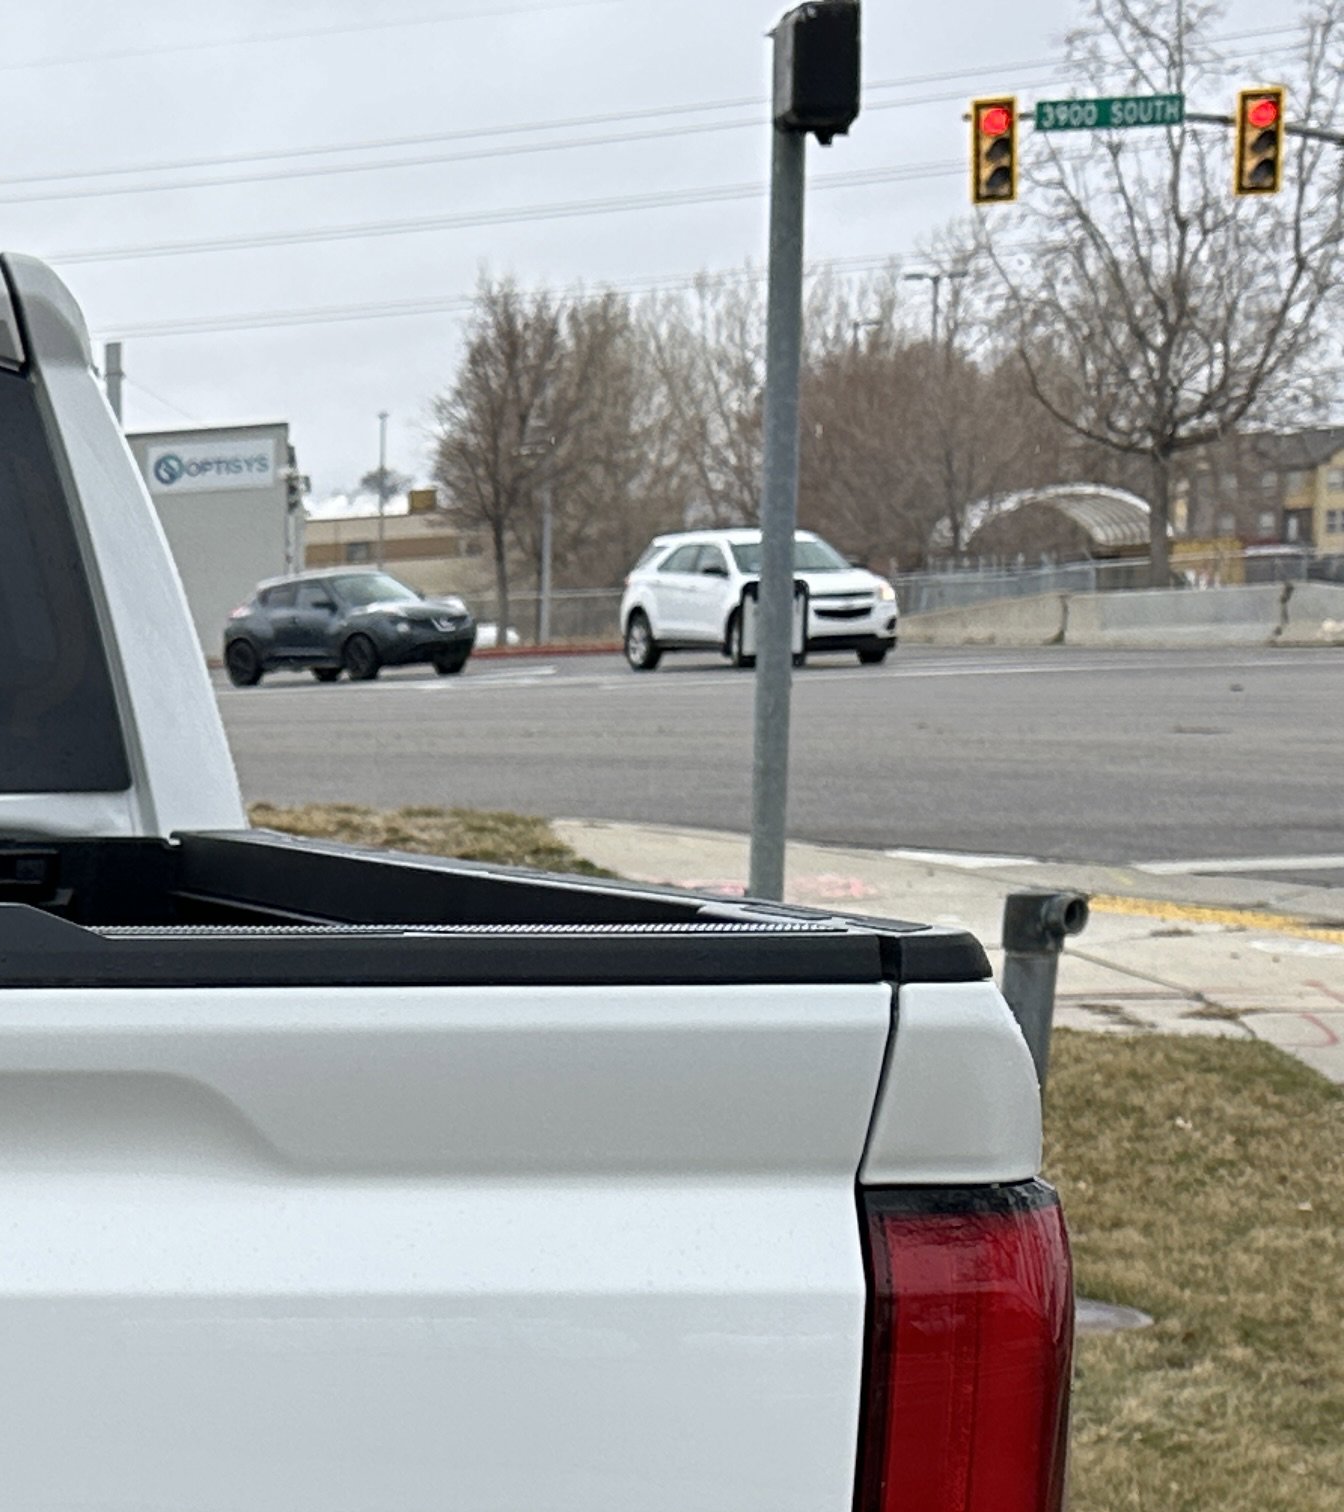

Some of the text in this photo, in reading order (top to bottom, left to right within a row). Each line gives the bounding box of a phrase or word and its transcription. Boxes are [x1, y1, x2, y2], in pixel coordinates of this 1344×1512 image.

[1041, 99, 1180, 126] 3900 SOUTH
[185, 454, 269, 477] OPTISYS
